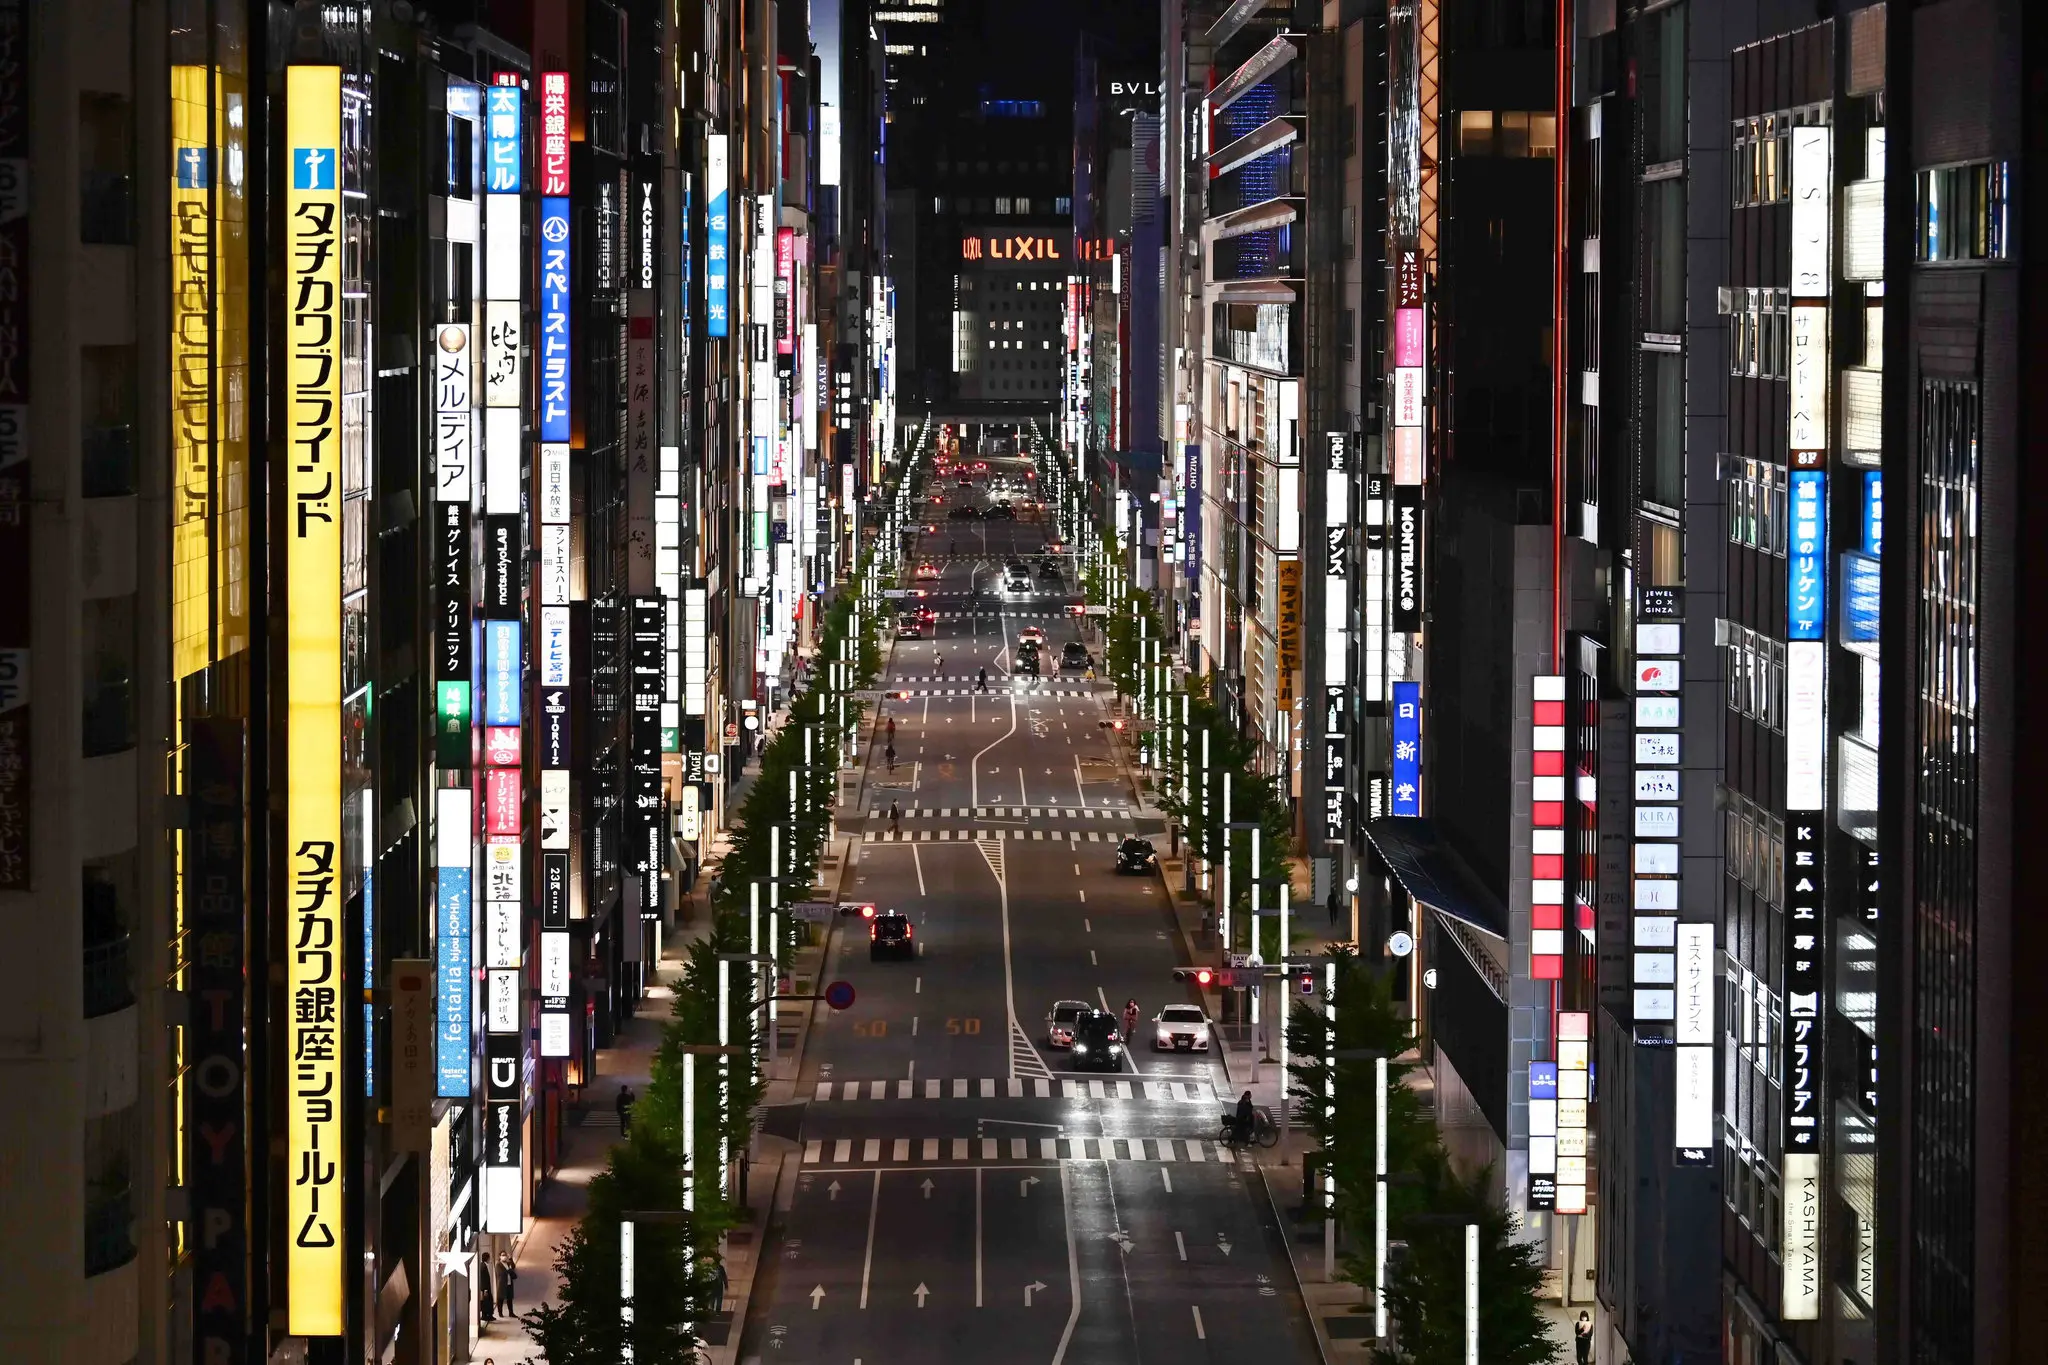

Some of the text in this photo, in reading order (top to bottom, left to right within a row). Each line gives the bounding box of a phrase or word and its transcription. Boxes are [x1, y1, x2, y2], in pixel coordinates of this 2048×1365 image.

[492, 90, 516, 190] 太陽ビル
[545, 75, 565, 194] 陽栄銀座ビル
[711, 215, 725, 320] 名鉄観光
[990, 236, 1060, 261] LIXIL
[295, 203, 335, 537] タチカワブラインド
[545, 250, 567, 423] スペーストラスト
[441, 358, 465, 488] メルディア
[819, 363, 829, 407] TASAKI
[550, 461, 562, 518] 南日本放送
[1190, 456, 1198, 489] MIZUHO
[1328, 528, 1345, 575] ダンス
[1401, 507, 1414, 598] MONTBLANC
[1798, 481, 1816, 612] のリケン
[447, 600, 460, 672] クリニック
[1799, 621, 1812, 630] 7F
[551, 715, 559, 766] TORAIZ
[689, 750, 702, 782] PIAGET
[1396, 703, 1417, 802] 日新堂
[1370, 778, 1382, 818] YAMAHA
[1640, 811, 1675, 822] KIRA
[444, 894, 462, 1042] festaria bijou SOPHIA
[1689, 936, 1701, 1033] エス・サイエンス
[295, 841, 336, 1248] タチカワ銀座ショールーム
[492, 1063, 516, 1088] U
[1795, 1133, 1811, 1143] 4F
[1803, 1177, 1816, 1297] KASHIYAMA
